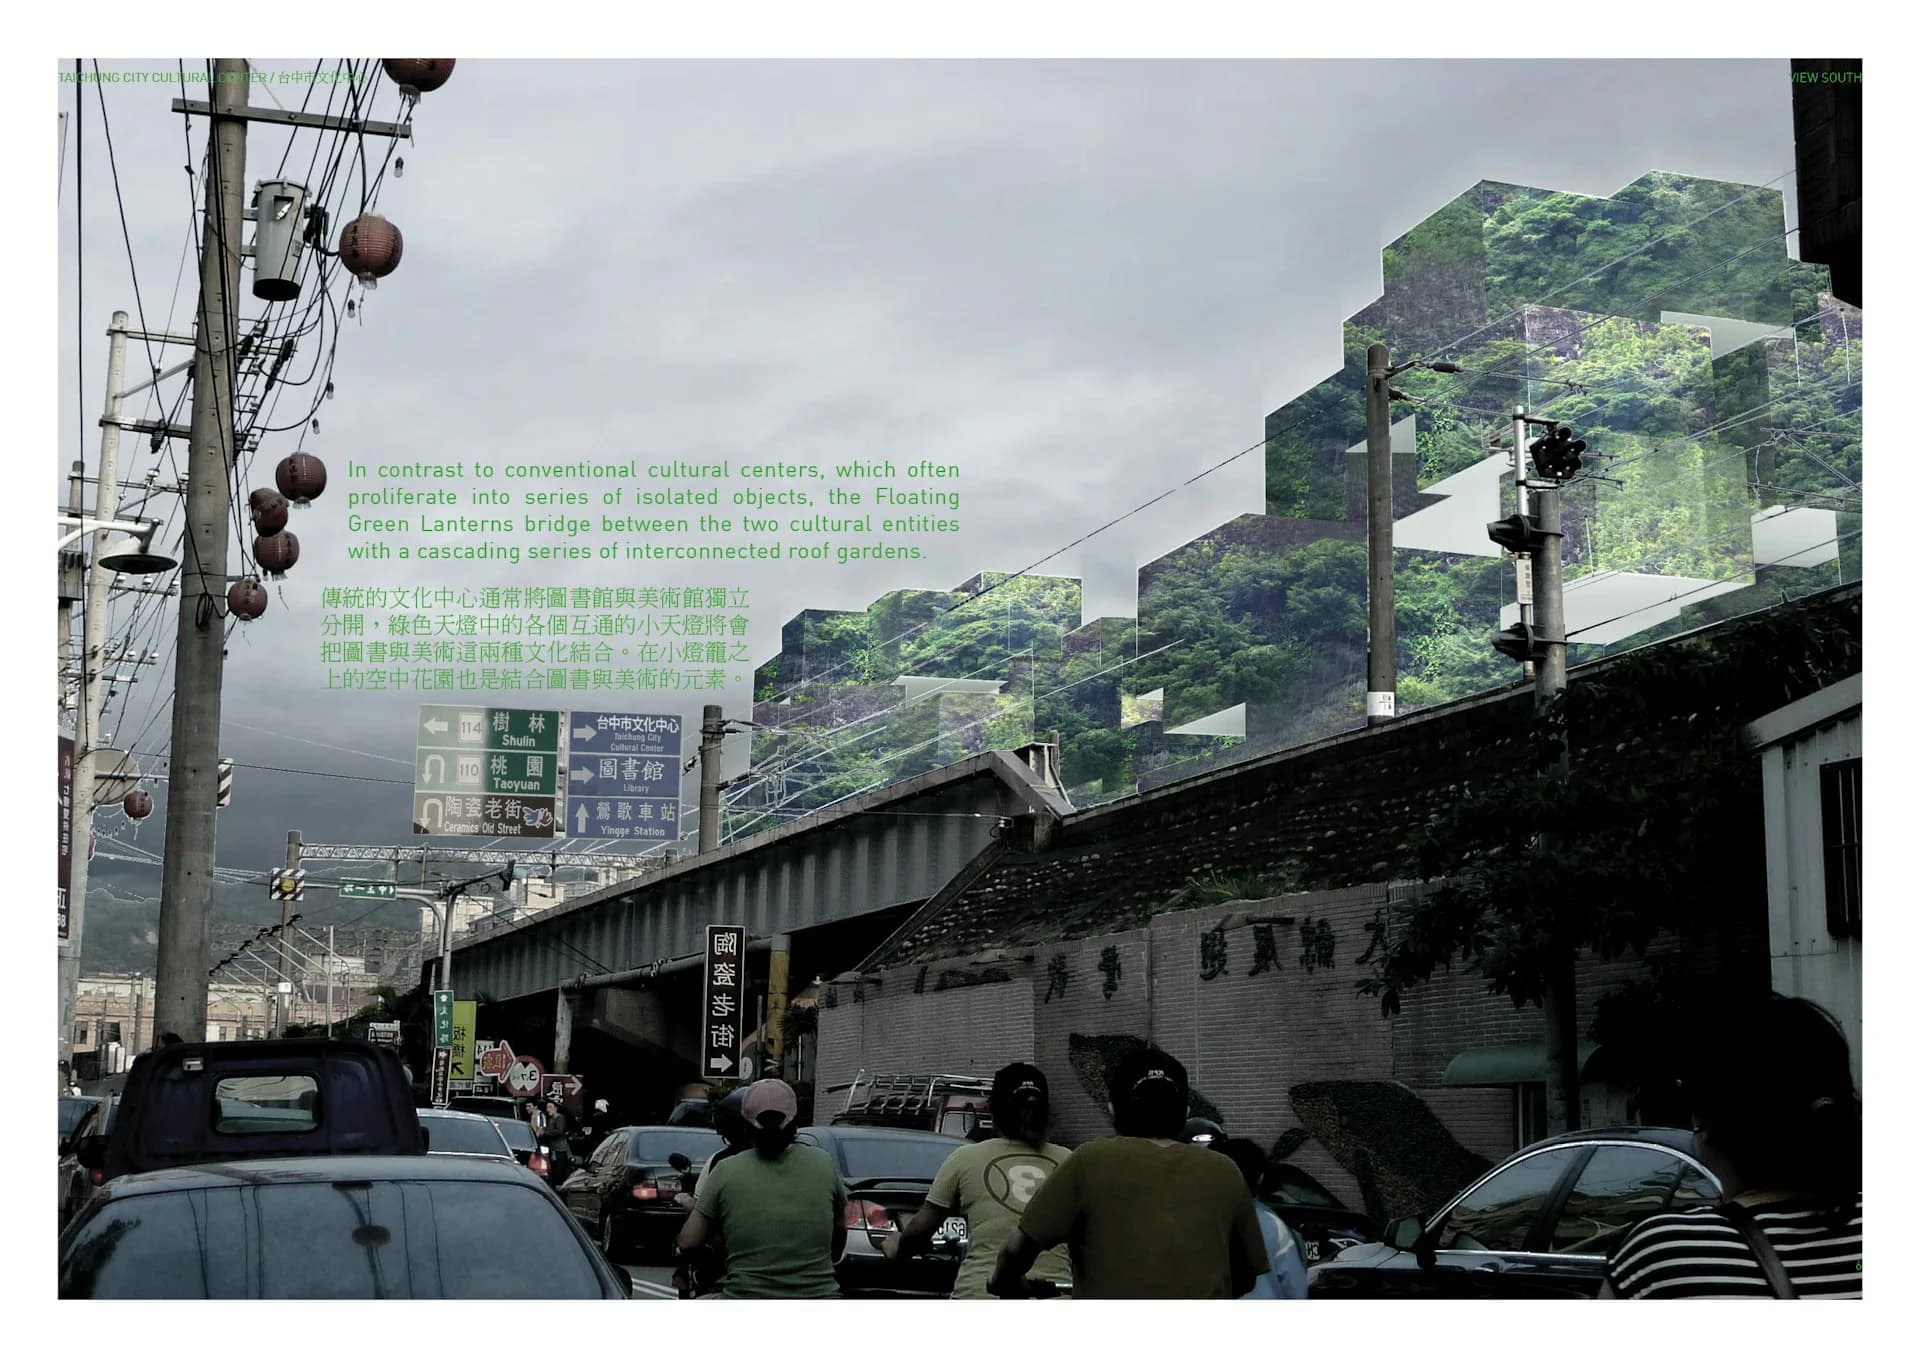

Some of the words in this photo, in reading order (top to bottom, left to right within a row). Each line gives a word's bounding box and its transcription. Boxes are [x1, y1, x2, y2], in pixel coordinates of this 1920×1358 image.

[462, 720, 481, 734] 114
[493, 711, 546, 734] 樹林
[596, 715, 680, 733] 台中市文化中心
[502, 735, 536, 747] Shulin
[614, 733, 645, 743] Taichung
[648, 733, 661, 744] City
[609, 743, 638, 752] Cultural
[641, 744, 664, 752] Center
[460, 762, 479, 777] 110
[490, 754, 544, 777] 桃園
[599, 757, 664, 781] 圖書館
[493, 778, 540, 792] Taoyuan
[624, 784, 650, 794] Library
[445, 795, 522, 821] 陶瓷老街
[444, 822, 479, 834] Ceramics
[482, 822, 494, 834] Old
[497, 822, 521, 834] Street
[601, 826, 630, 836] Yingge
[634, 826, 665, 836] Station
